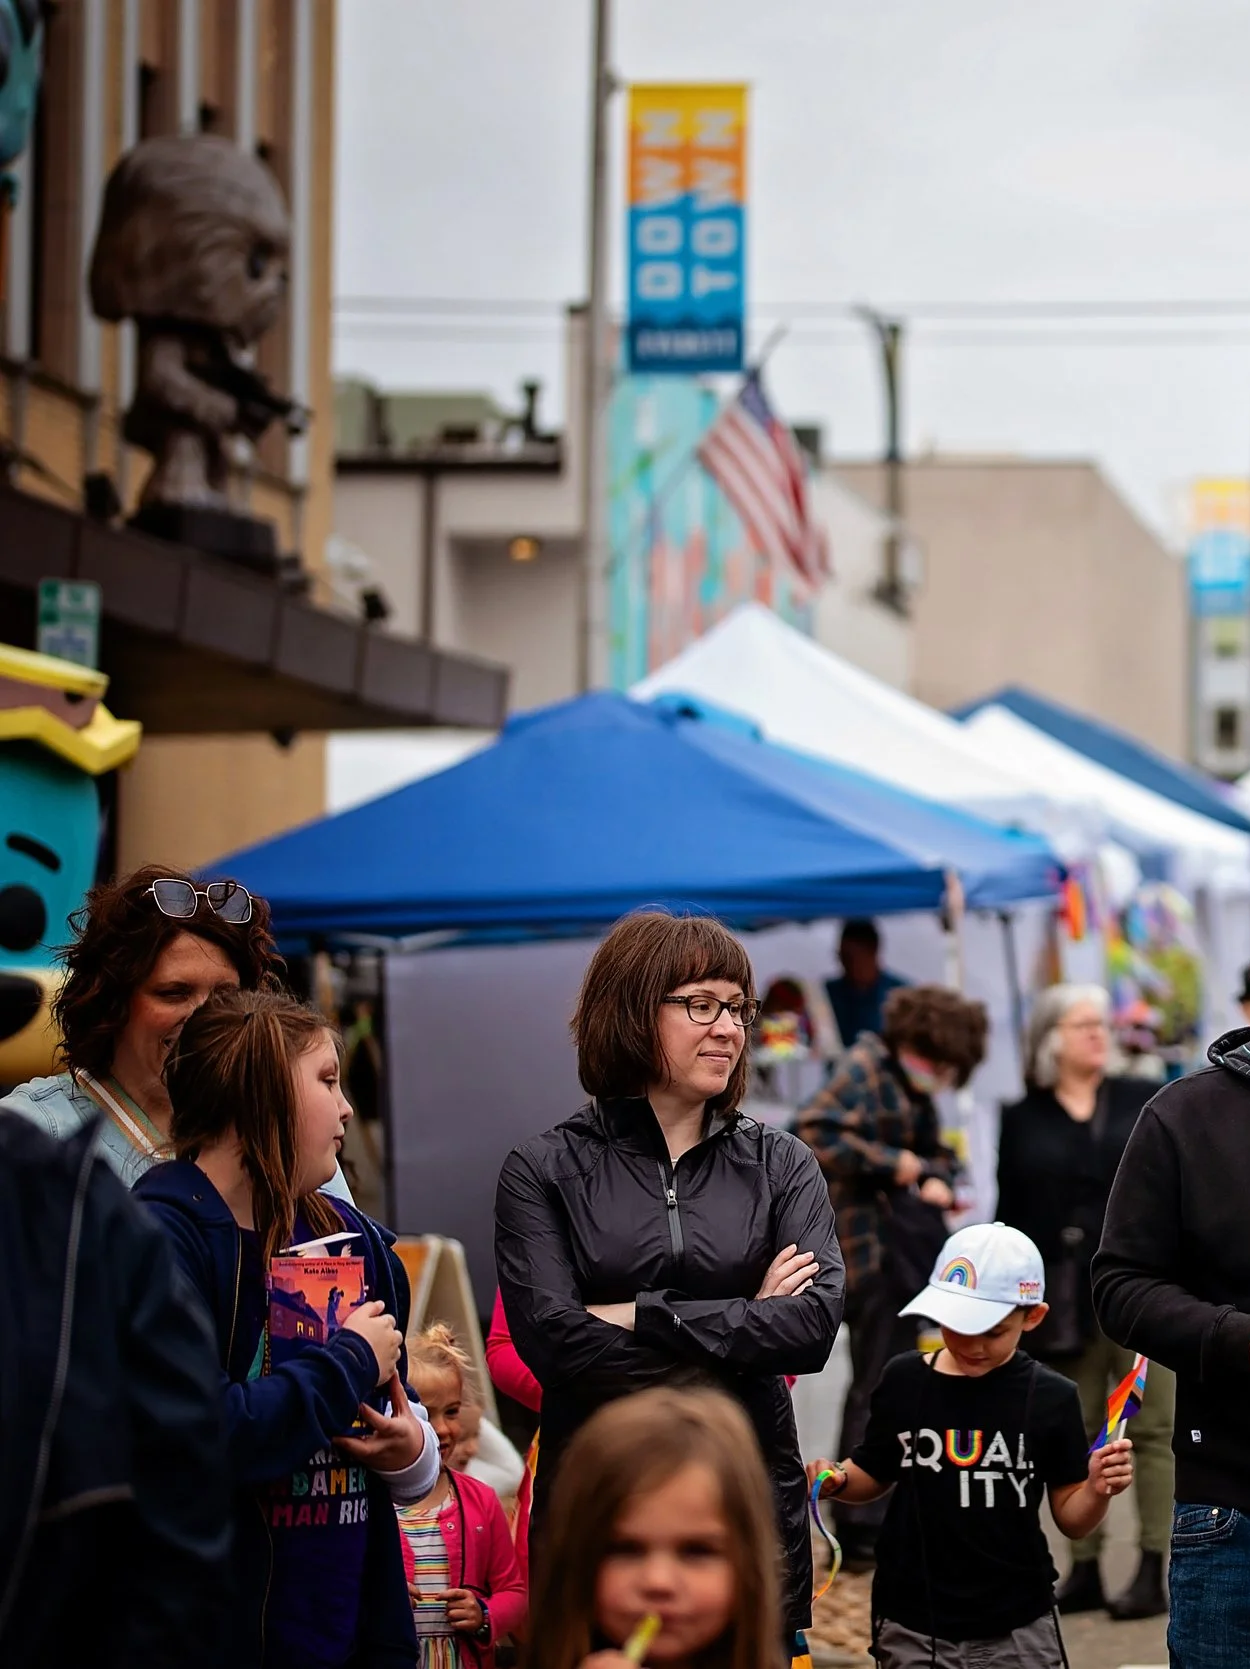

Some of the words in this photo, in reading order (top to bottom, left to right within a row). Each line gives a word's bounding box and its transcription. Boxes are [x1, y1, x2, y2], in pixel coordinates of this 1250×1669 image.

[635, 108, 684, 301] DOWN
[690, 108, 738, 299] TOWN
[897, 1428, 1035, 1473] EQUAL
[959, 1470, 1035, 1508] ITY
